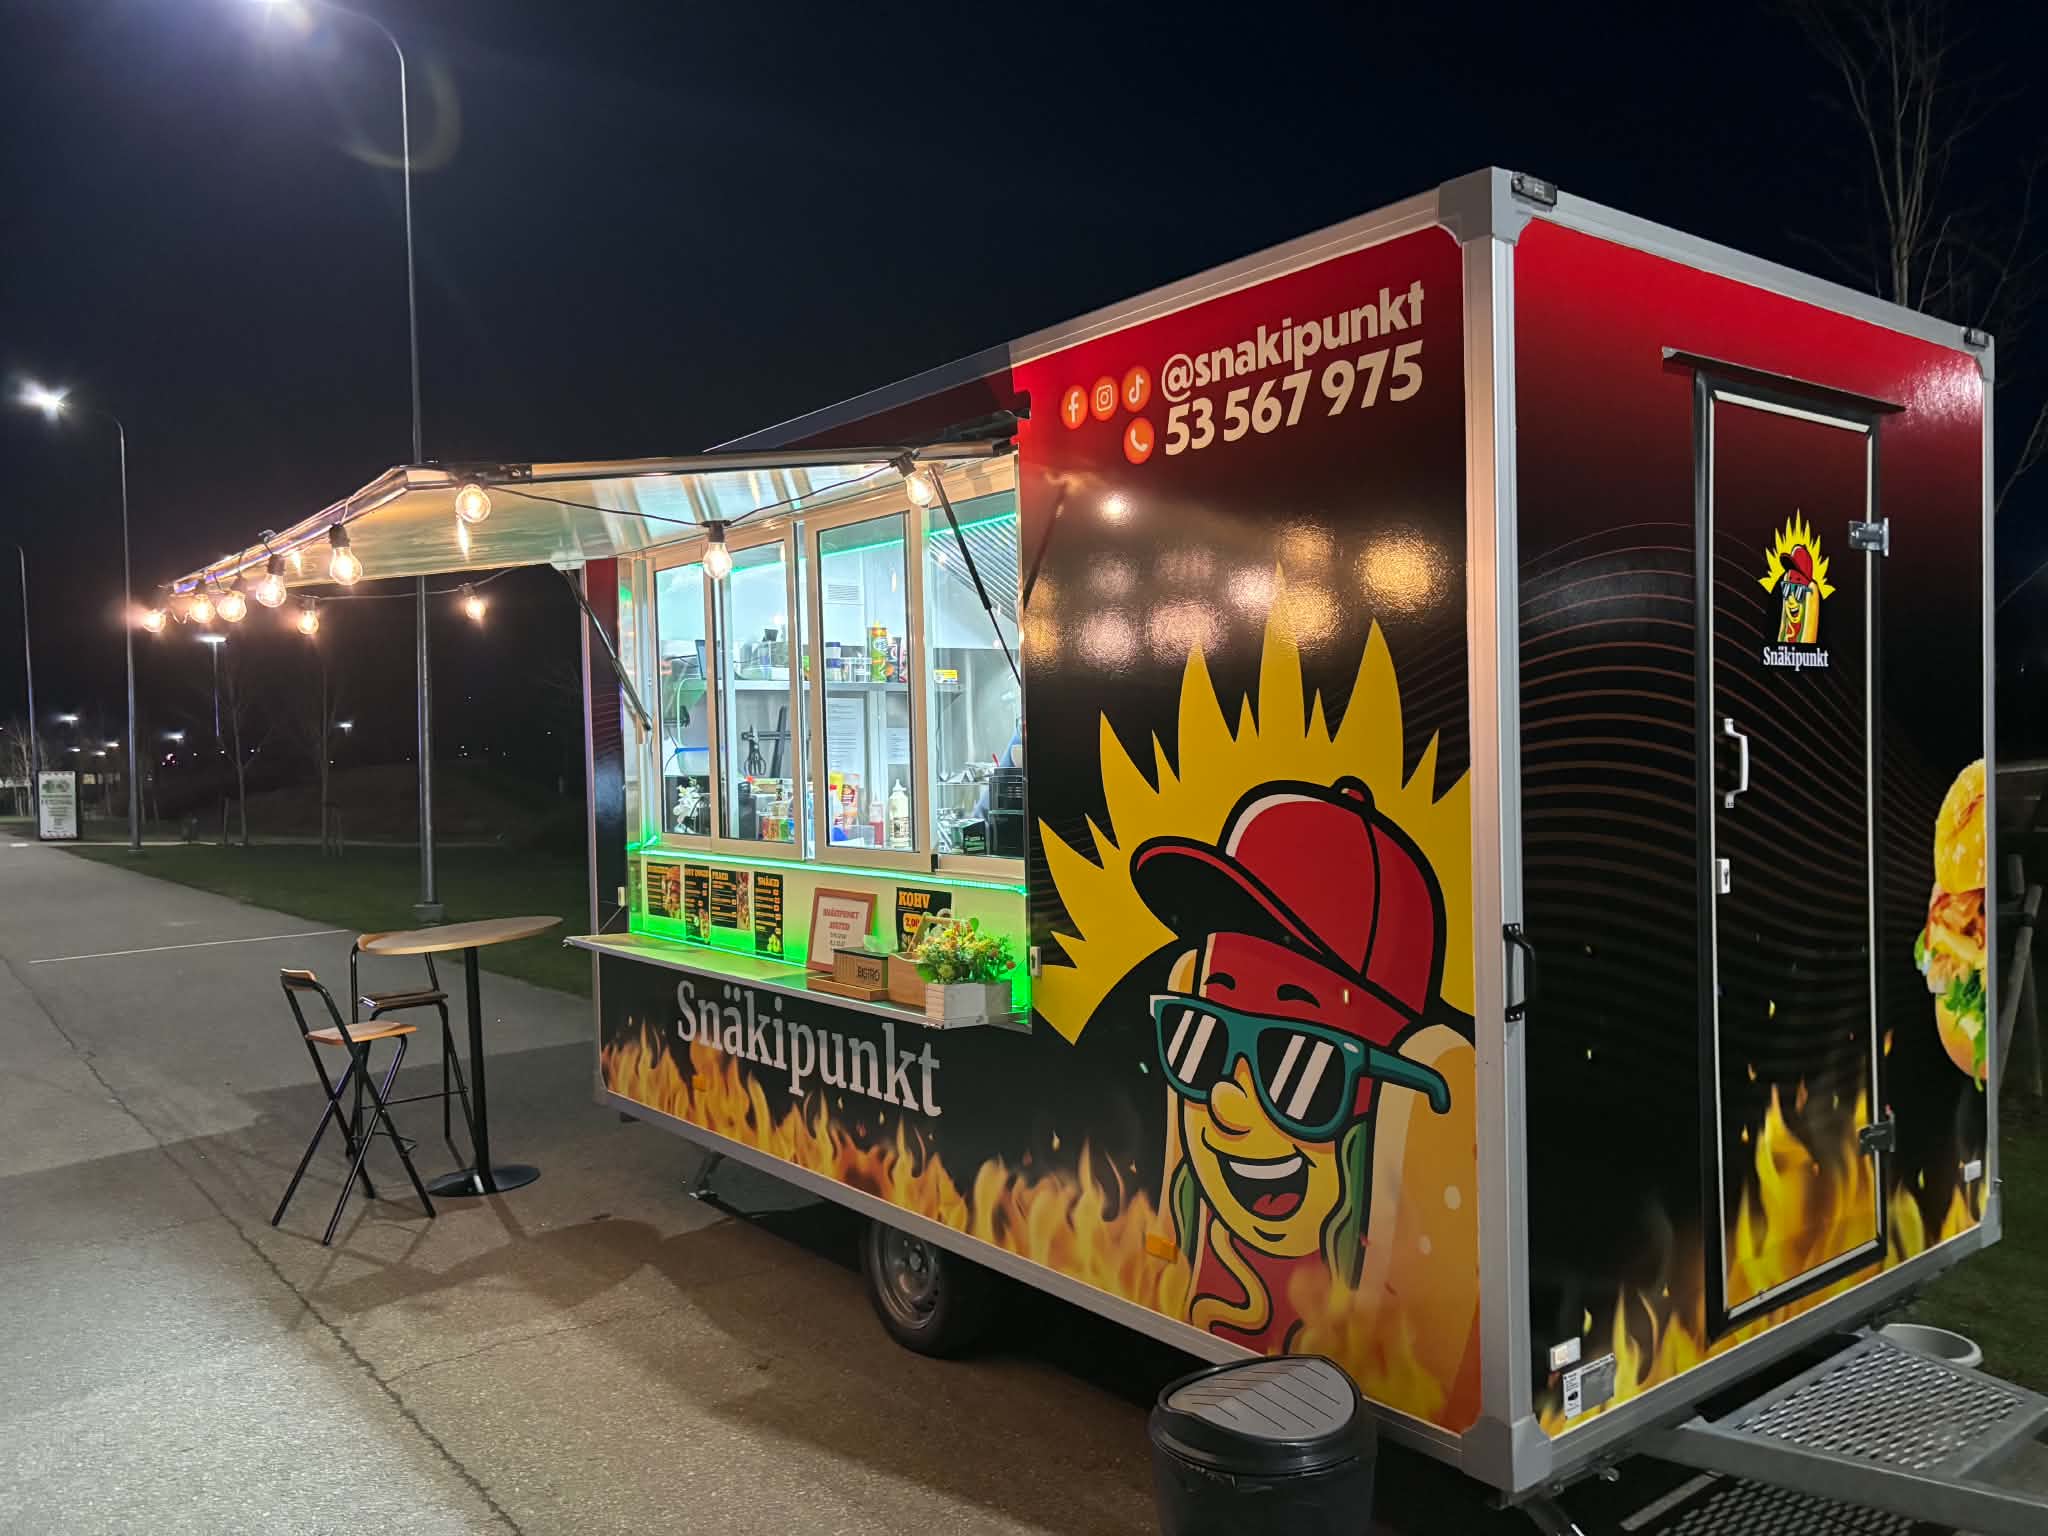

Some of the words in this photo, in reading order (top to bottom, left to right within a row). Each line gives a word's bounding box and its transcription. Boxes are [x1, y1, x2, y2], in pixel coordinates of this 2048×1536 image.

[1162, 280, 1424, 402] @snakipunkt
[1165, 398, 1215, 456] 53
[1223, 369, 1312, 442] 567
[1321, 340, 1423, 416] 975
[1763, 645, 1829, 671] Snäkipunkt
[898, 890, 931, 909] KOHV
[677, 980, 942, 1117] Snäkipunkt
